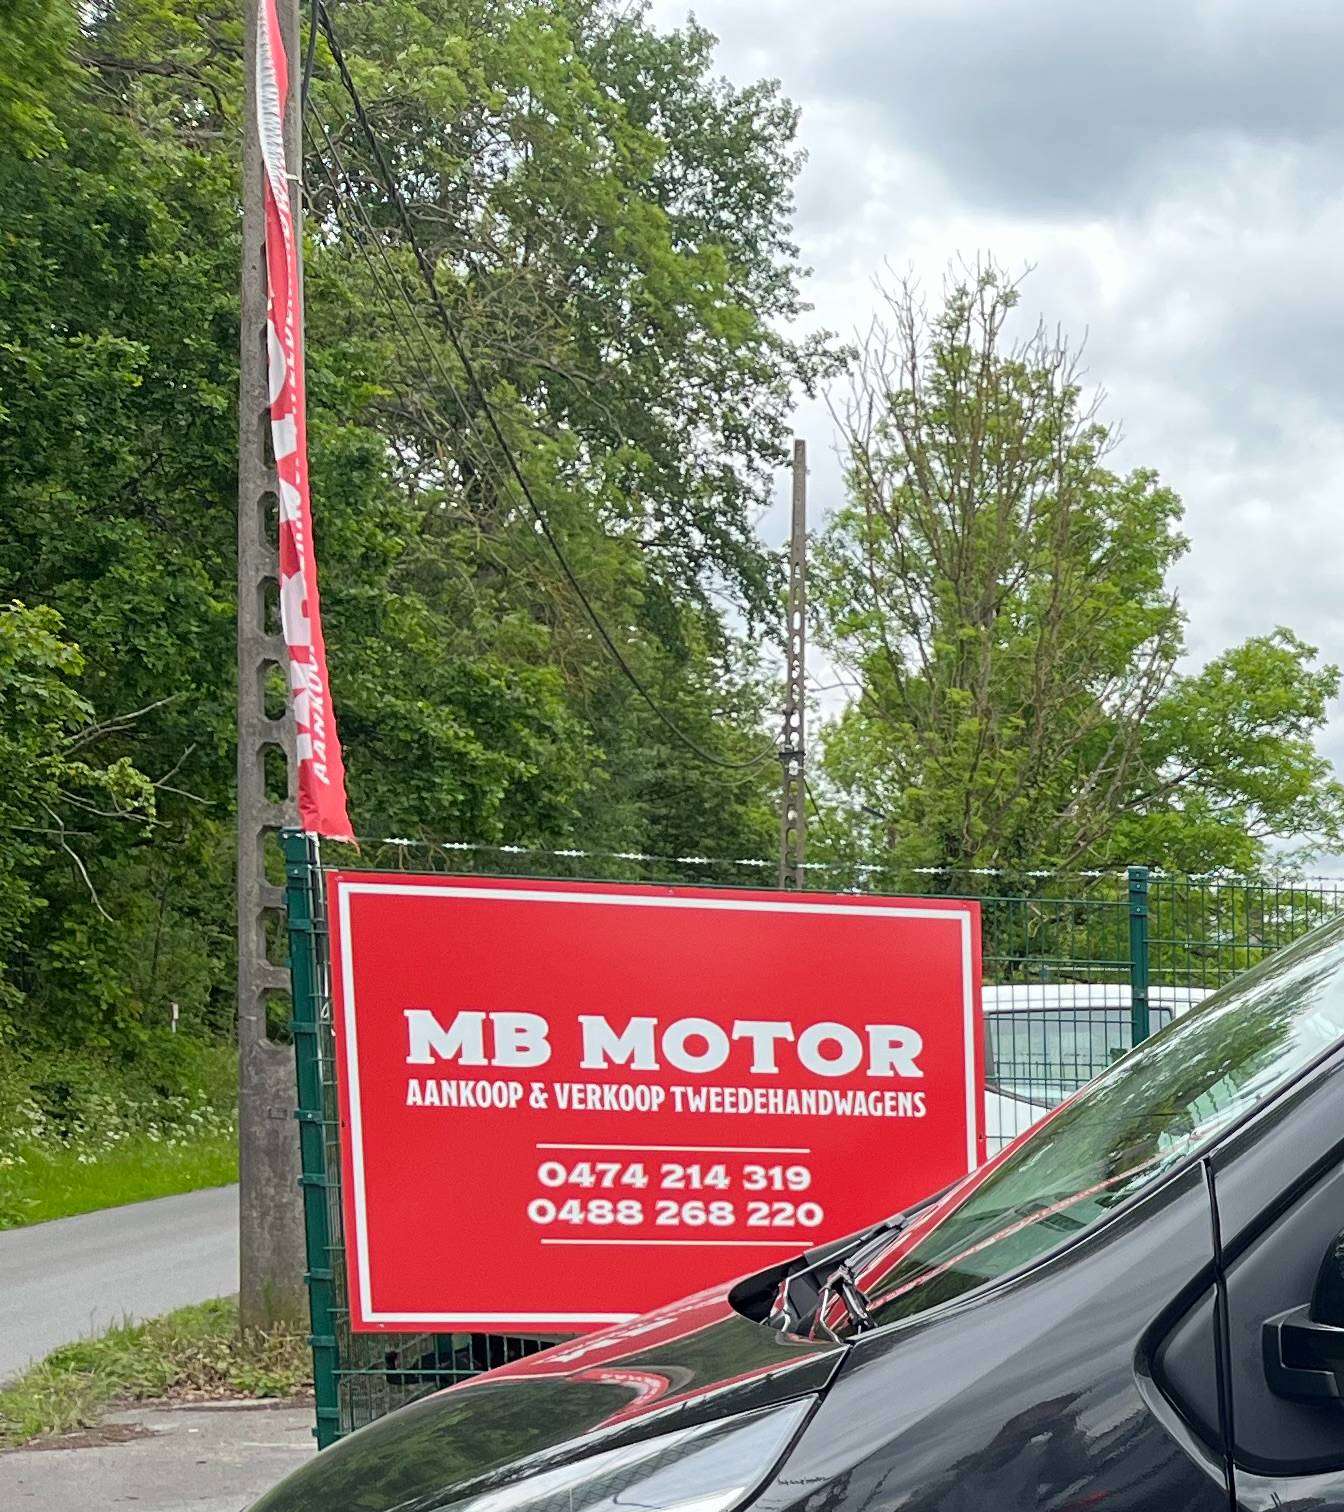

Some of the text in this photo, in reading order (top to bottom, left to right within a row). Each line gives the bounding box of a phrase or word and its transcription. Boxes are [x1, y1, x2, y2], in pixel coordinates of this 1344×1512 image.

[306, 646, 330, 785] AANKO
[403, 1009, 924, 1079] MB MOTOR
[406, 1078, 927, 1118] AANKOOP & VERKOOP TWEEDEHANDWAGENS
[537, 1161, 812, 1192] 0474 214 319
[527, 1198, 824, 1228] 0488 268 220
